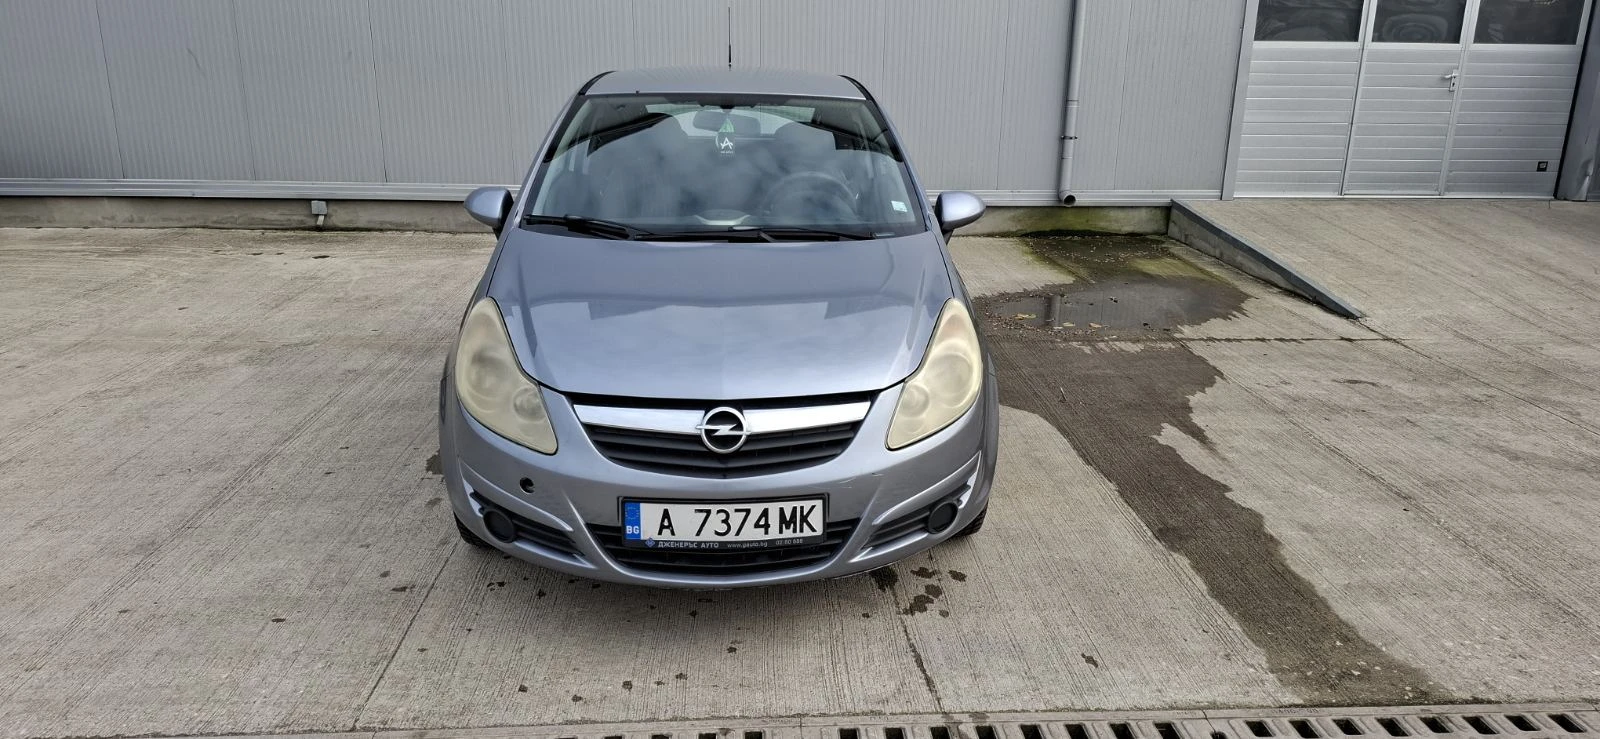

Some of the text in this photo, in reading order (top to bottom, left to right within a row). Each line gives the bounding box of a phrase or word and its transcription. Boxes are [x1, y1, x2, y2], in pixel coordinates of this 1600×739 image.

[626, 526, 640, 534] BG
[657, 504, 818, 537] A 7374 MK
